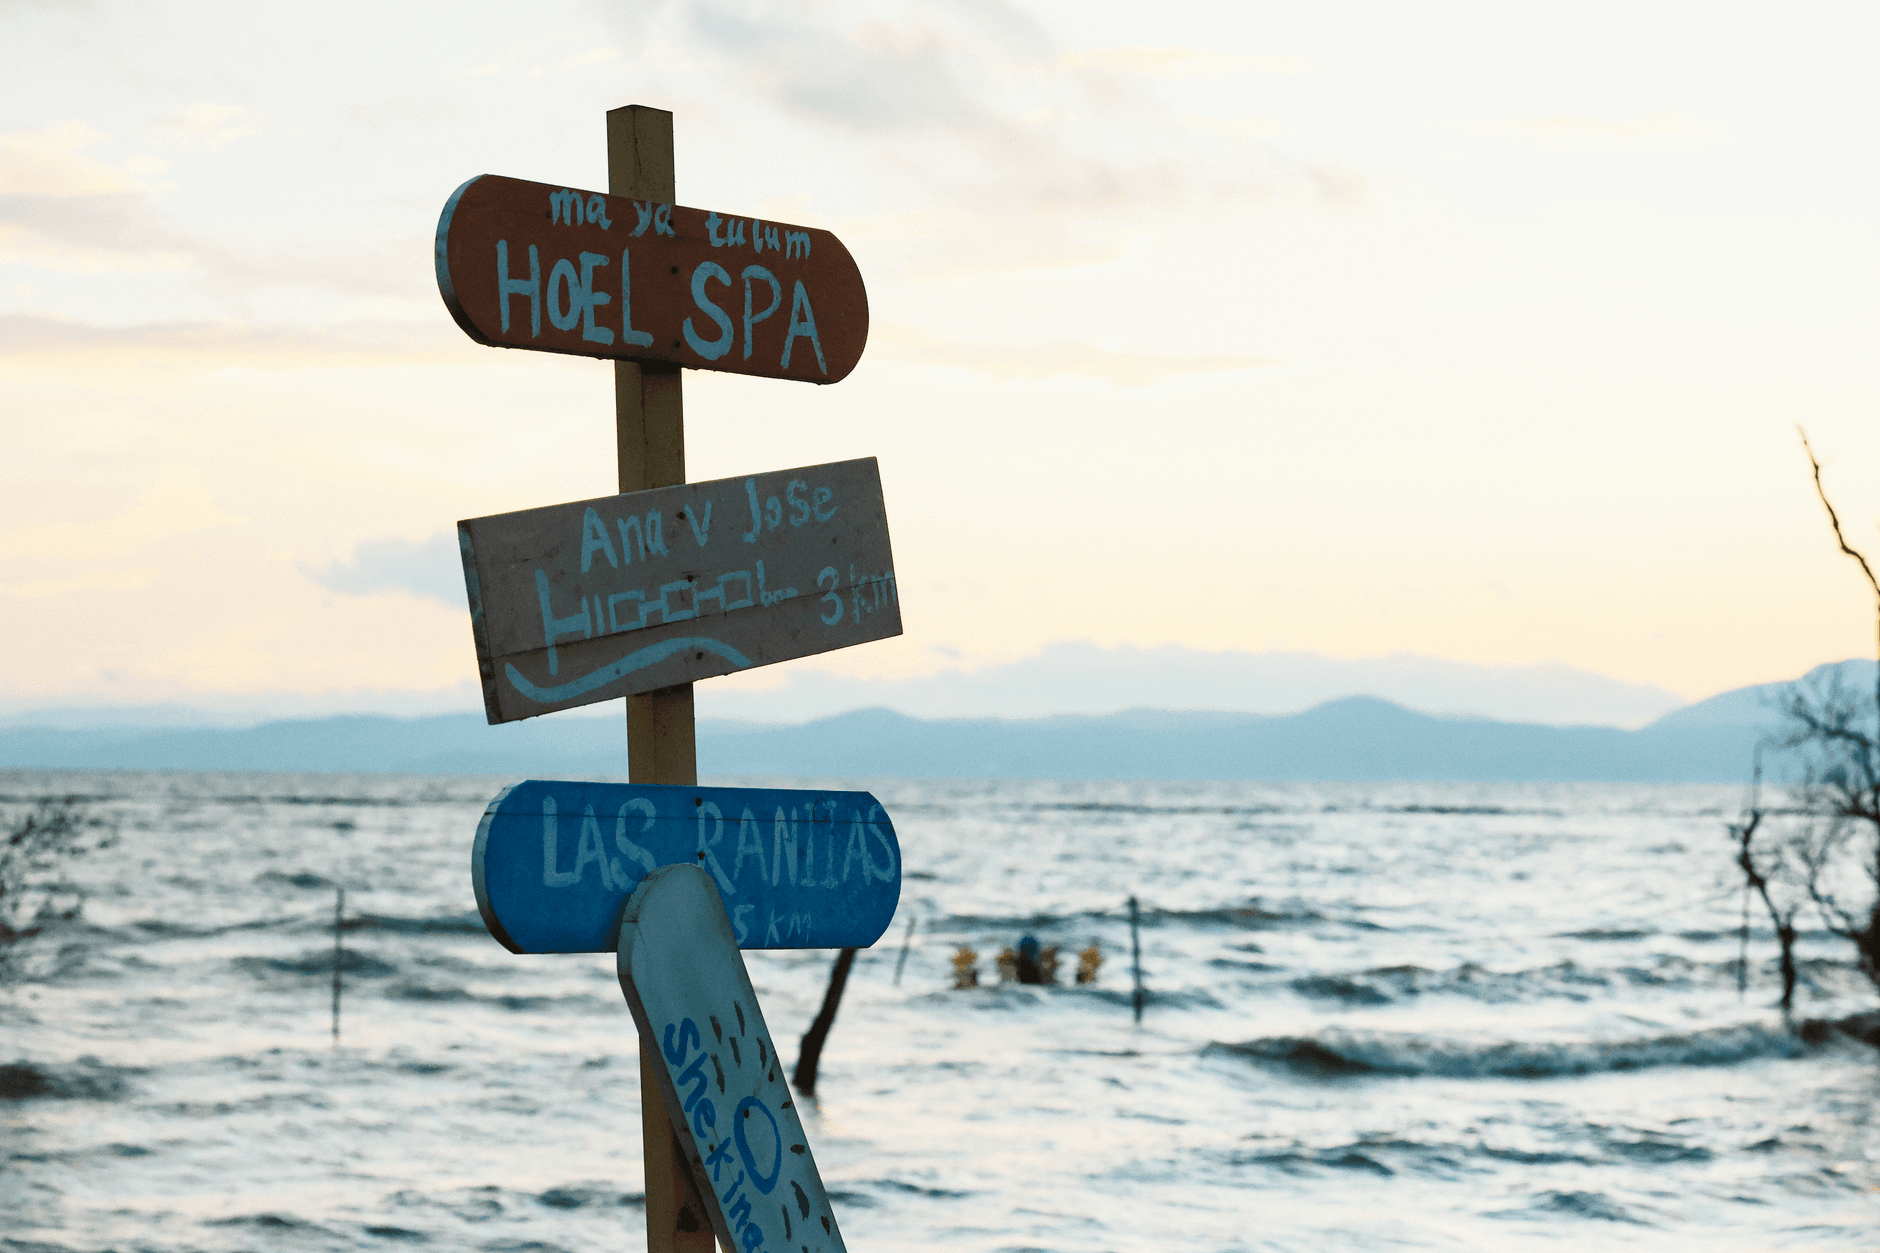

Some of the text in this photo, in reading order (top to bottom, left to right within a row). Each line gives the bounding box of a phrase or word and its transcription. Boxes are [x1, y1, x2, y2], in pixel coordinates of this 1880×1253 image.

[549, 188, 612, 231] ma
[705, 212, 812, 261] tulum
[497, 240, 828, 375] HOEL SPA
[581, 506, 669, 573] Ana
[817, 566, 844, 626] 3
[542, 795, 657, 893] LAS
